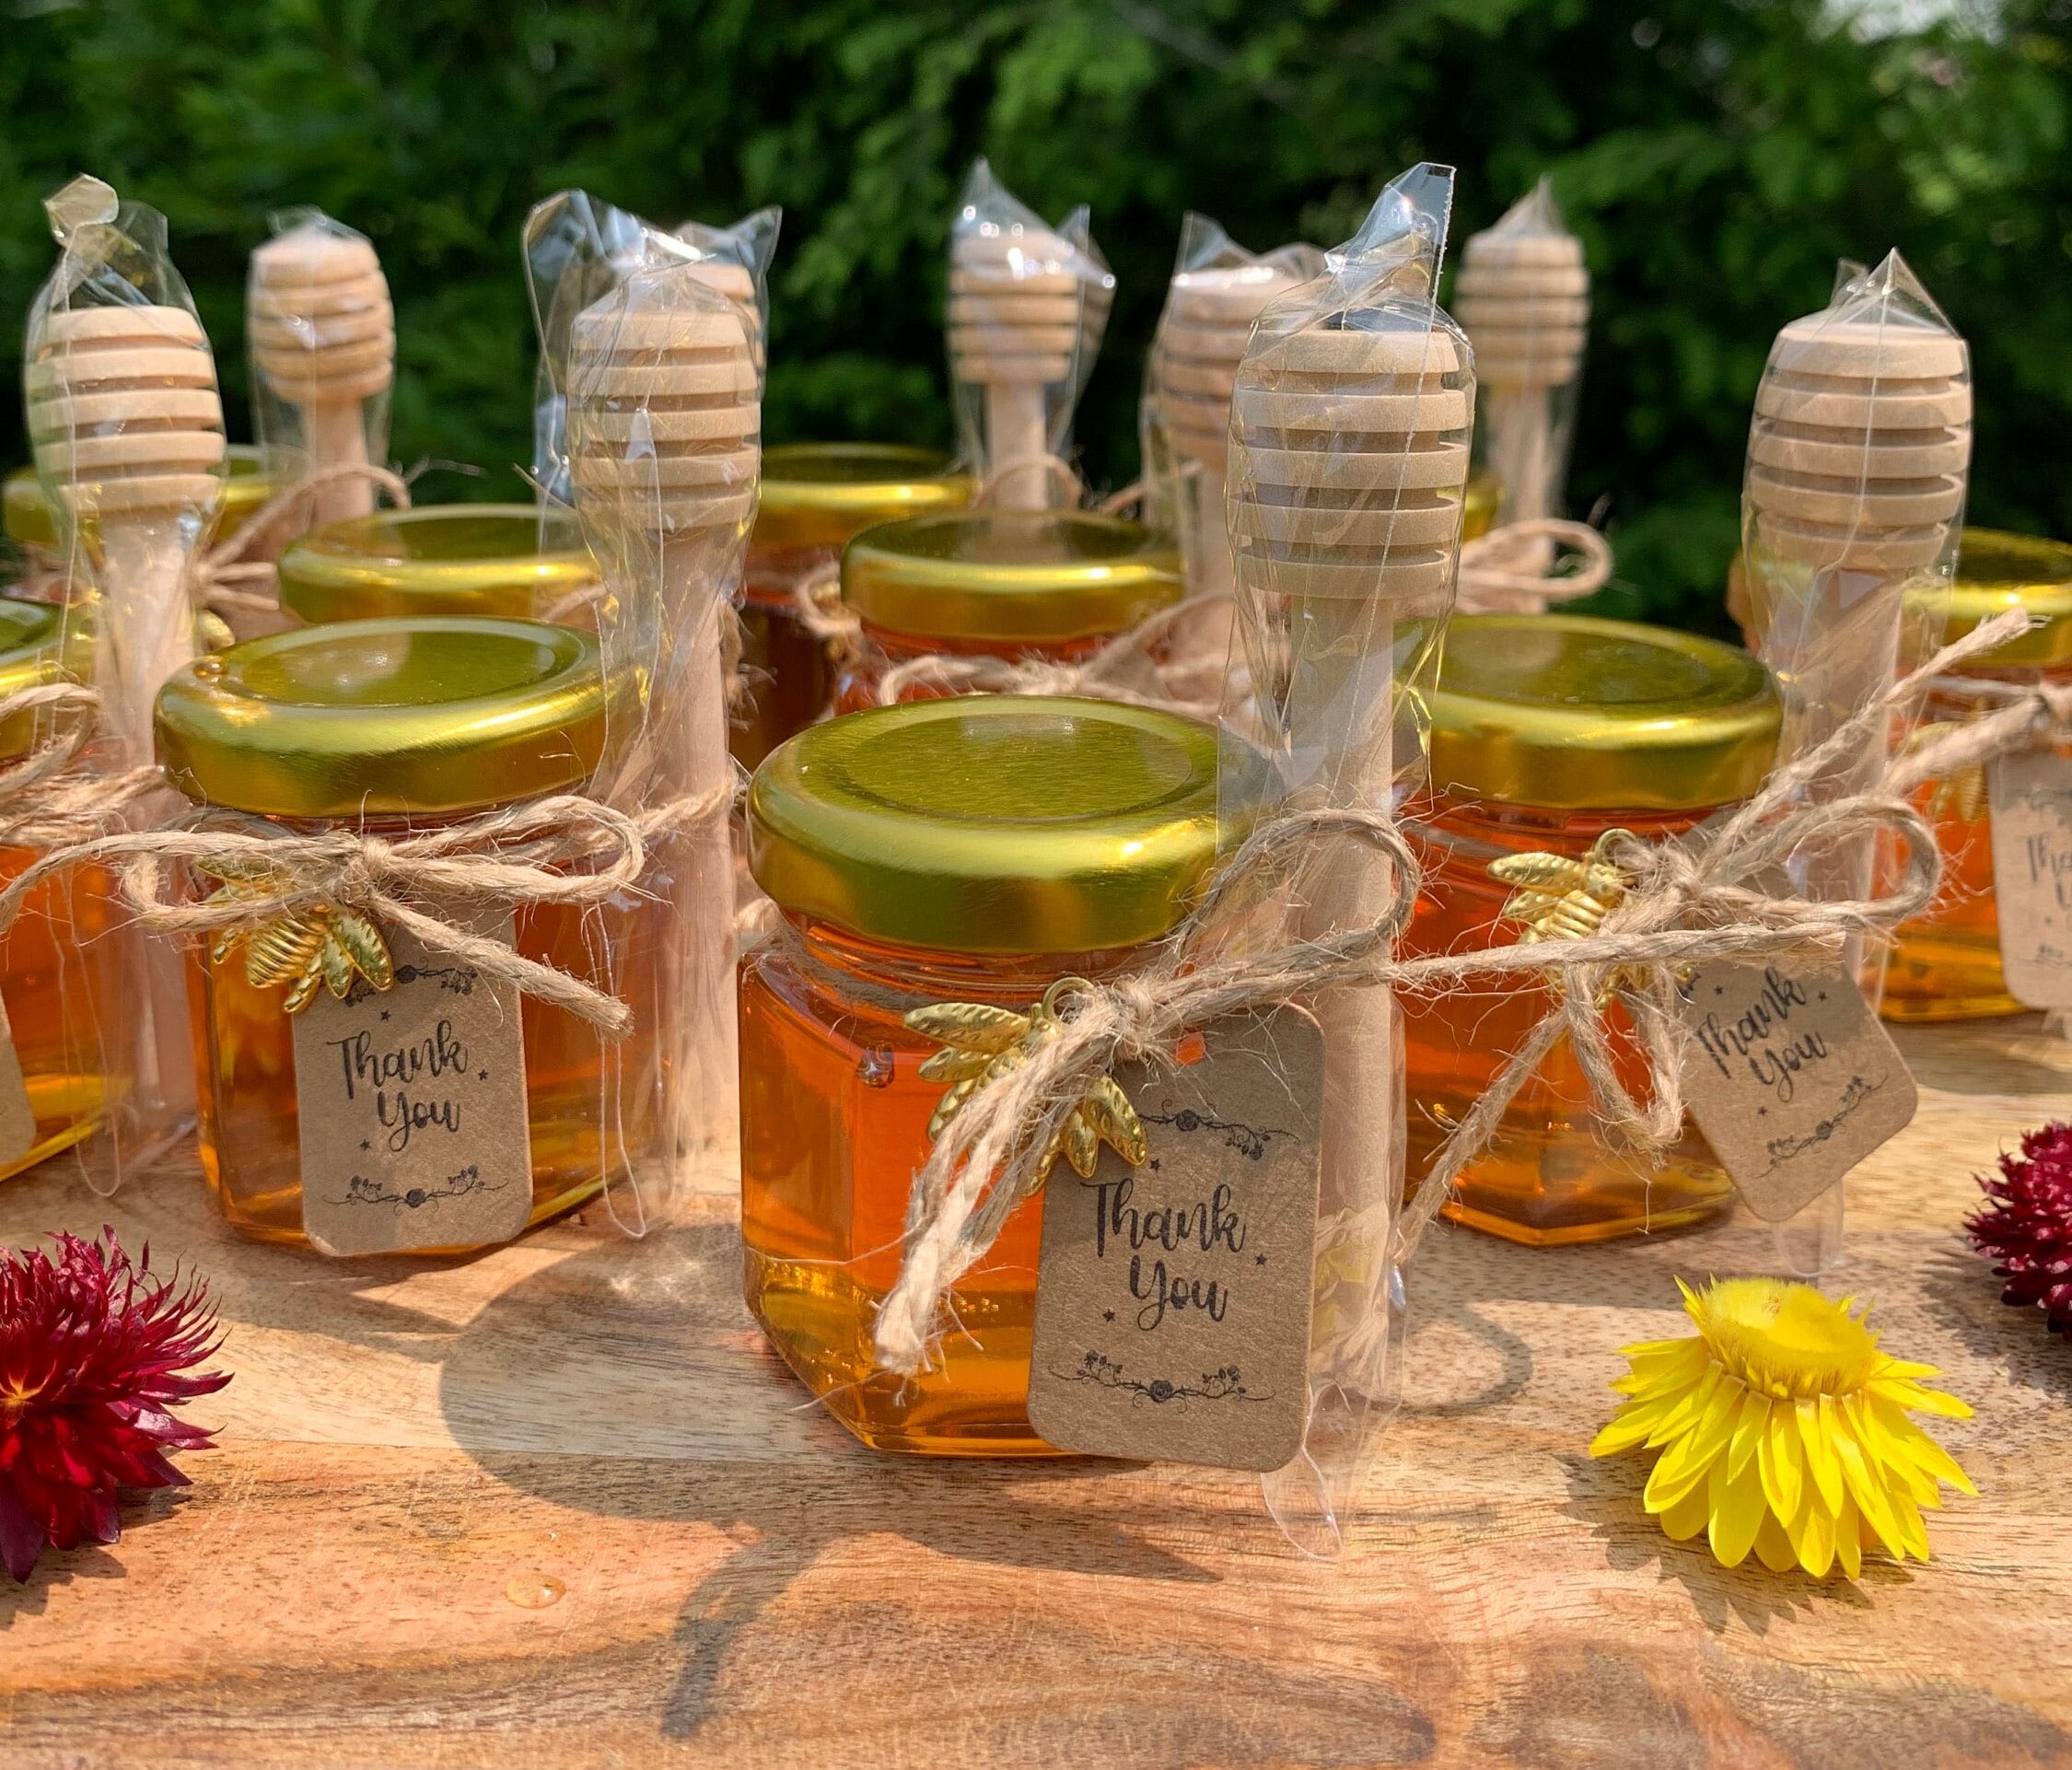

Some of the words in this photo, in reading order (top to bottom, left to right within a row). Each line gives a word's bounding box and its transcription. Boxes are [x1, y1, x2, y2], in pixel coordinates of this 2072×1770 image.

[326, 1019, 469, 1100] Thank
[1694, 966, 1807, 1079] Thank
[1749, 1031, 1828, 1103] You
[378, 1090, 460, 1152] You
[1079, 1177, 1246, 1258] Thank
[1129, 1254, 1228, 1332] You
